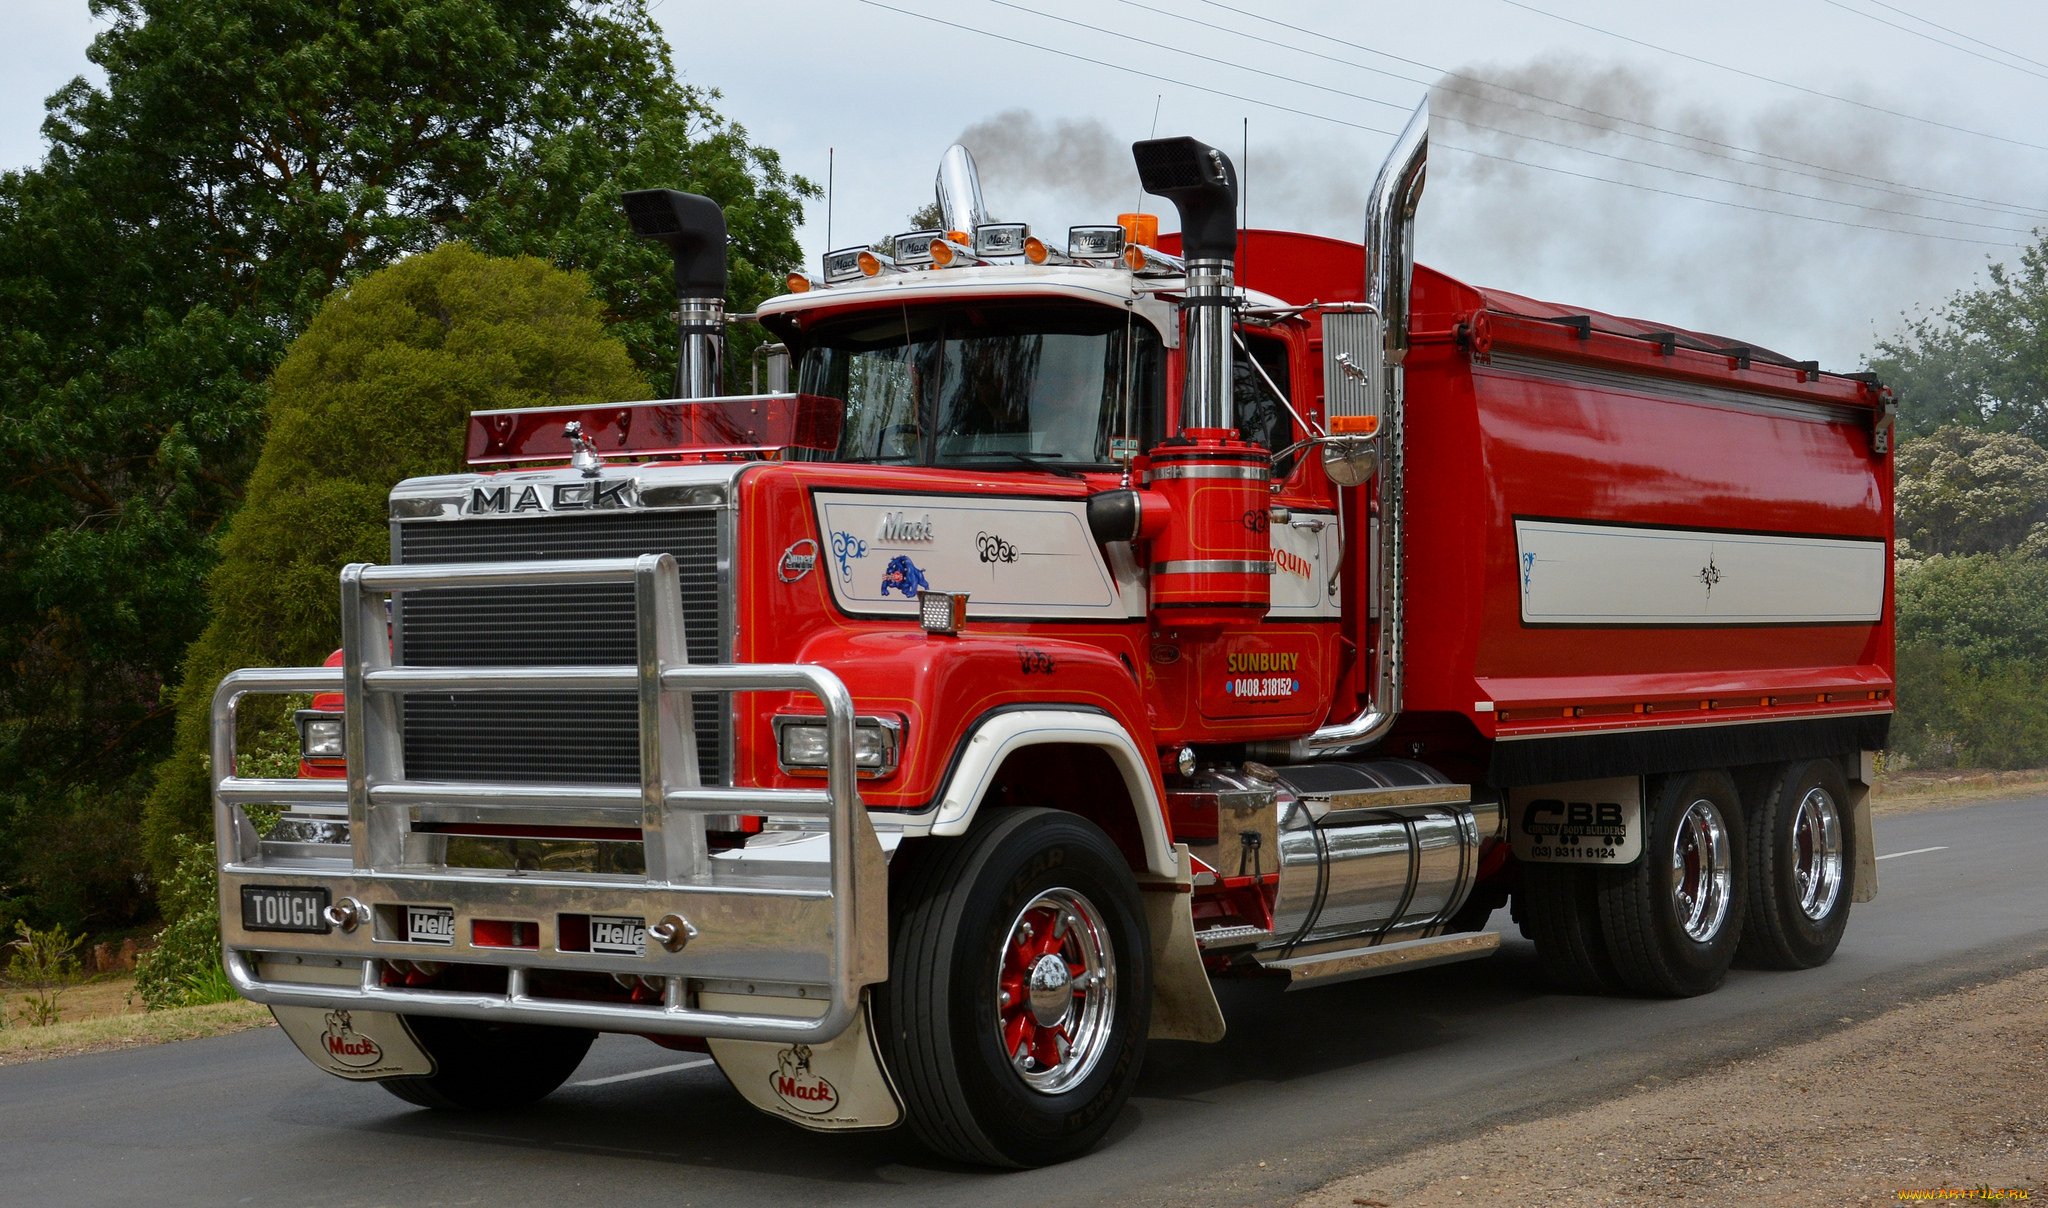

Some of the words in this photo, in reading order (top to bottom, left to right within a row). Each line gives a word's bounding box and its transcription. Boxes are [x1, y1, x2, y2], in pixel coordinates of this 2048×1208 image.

[905, 241, 929, 254] Mack
[986, 233, 1011, 246] Mack
[1080, 235, 1106, 248] Mack
[832, 258, 857, 270] Mack
[472, 478, 636, 515] MACK
[878, 511, 934, 541] Mack
[1228, 652, 1299, 674] SUNBURY
[1235, 677, 1292, 697] 0408.318152
[1522, 799, 1623, 834] CBB
[1563, 825, 1585, 835] BODY
[1586, 825, 1625, 836] BUILDERS
[1531, 846, 1552, 858] (03)
[1555, 847, 1582, 858] 9311
[1586, 847, 1616, 858] 6124
[252, 895, 318, 927] TOUGH
[413, 913, 455, 935] Hella
[596, 923, 647, 945] Hella
[328, 1036, 378, 1056] Mack
[778, 1076, 834, 1102] Mack
